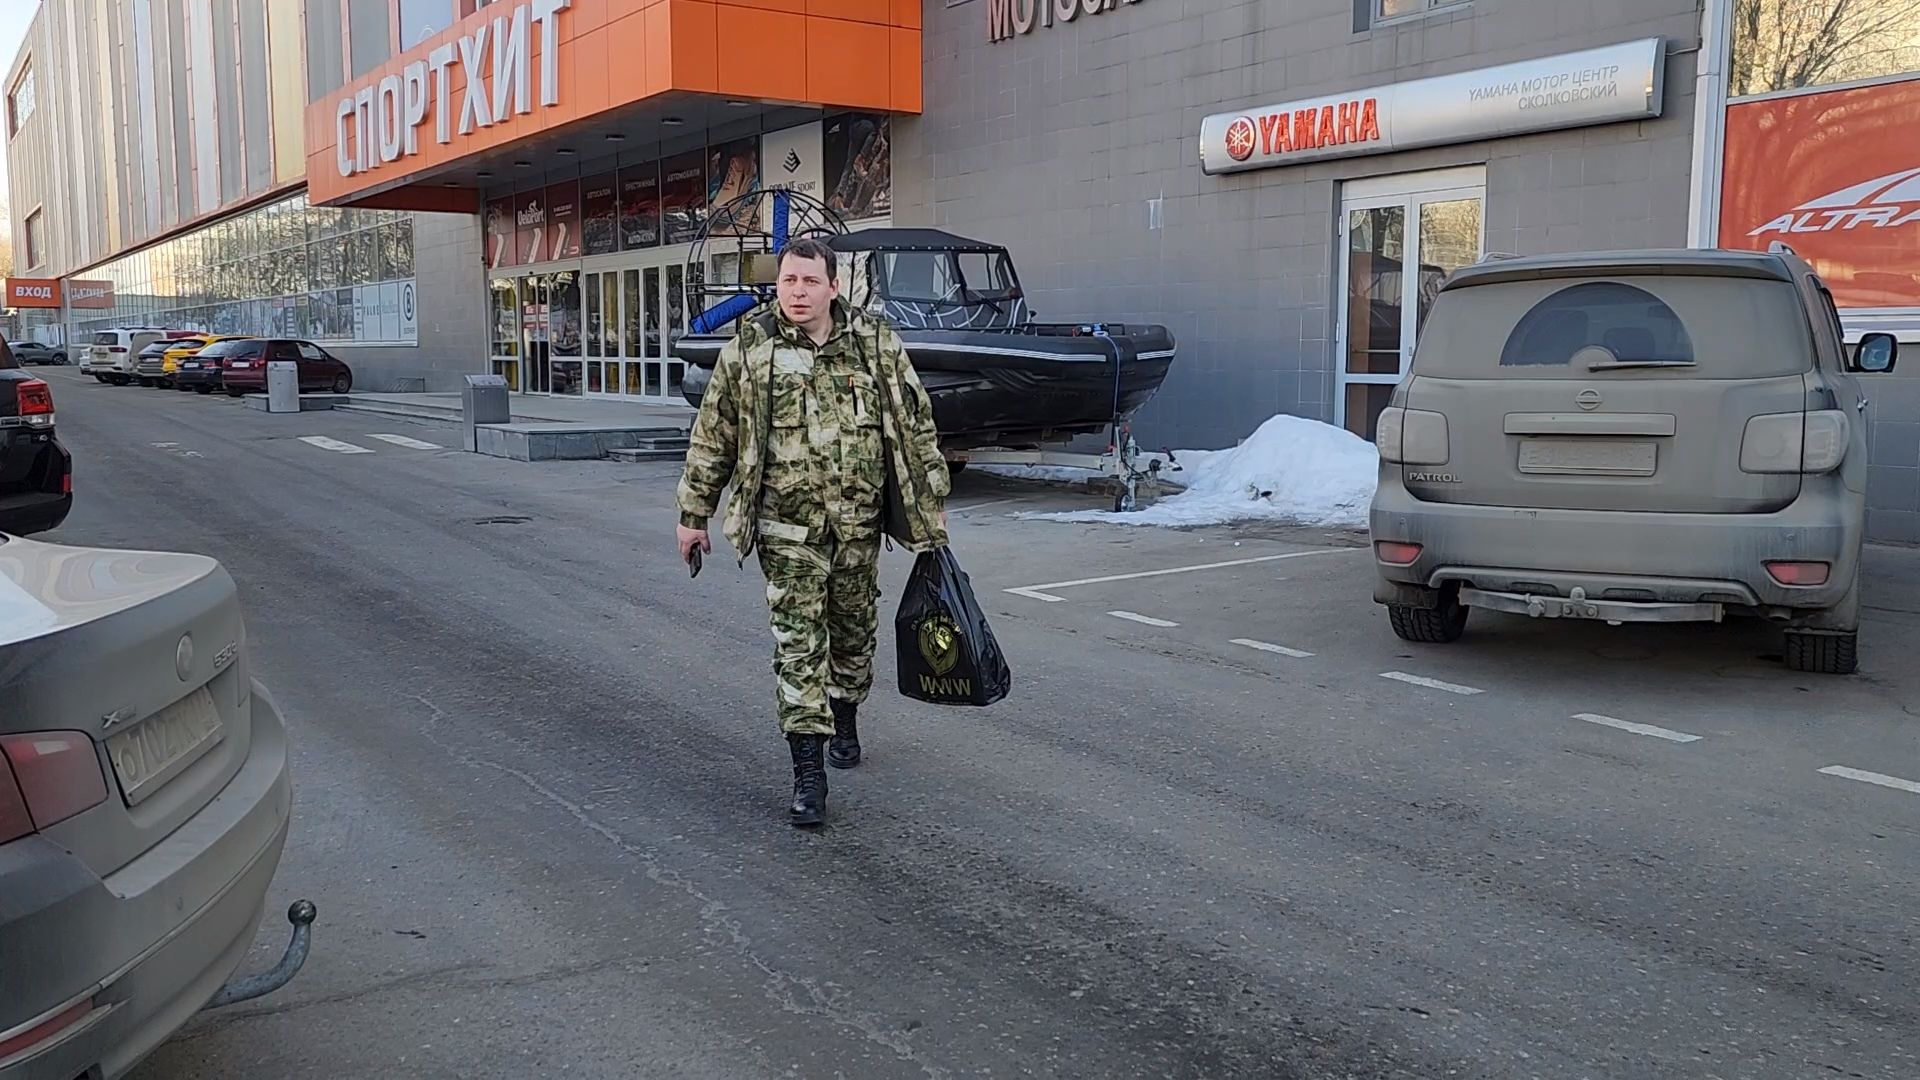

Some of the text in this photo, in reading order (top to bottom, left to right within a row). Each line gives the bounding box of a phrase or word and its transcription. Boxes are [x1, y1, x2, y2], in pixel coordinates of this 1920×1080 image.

[336, 0, 571, 177] СПОРТХИТ
[1468, 65, 1619, 101] YAMAHA МОТОР ЦЕНТР
[1518, 81, 1618, 110] СКОЛКОВСКИЙ
[1259, 98, 1379, 154] YAMAHA
[15, 286, 52, 298] ВХОД
[1408, 472, 1462, 483] PATROL
